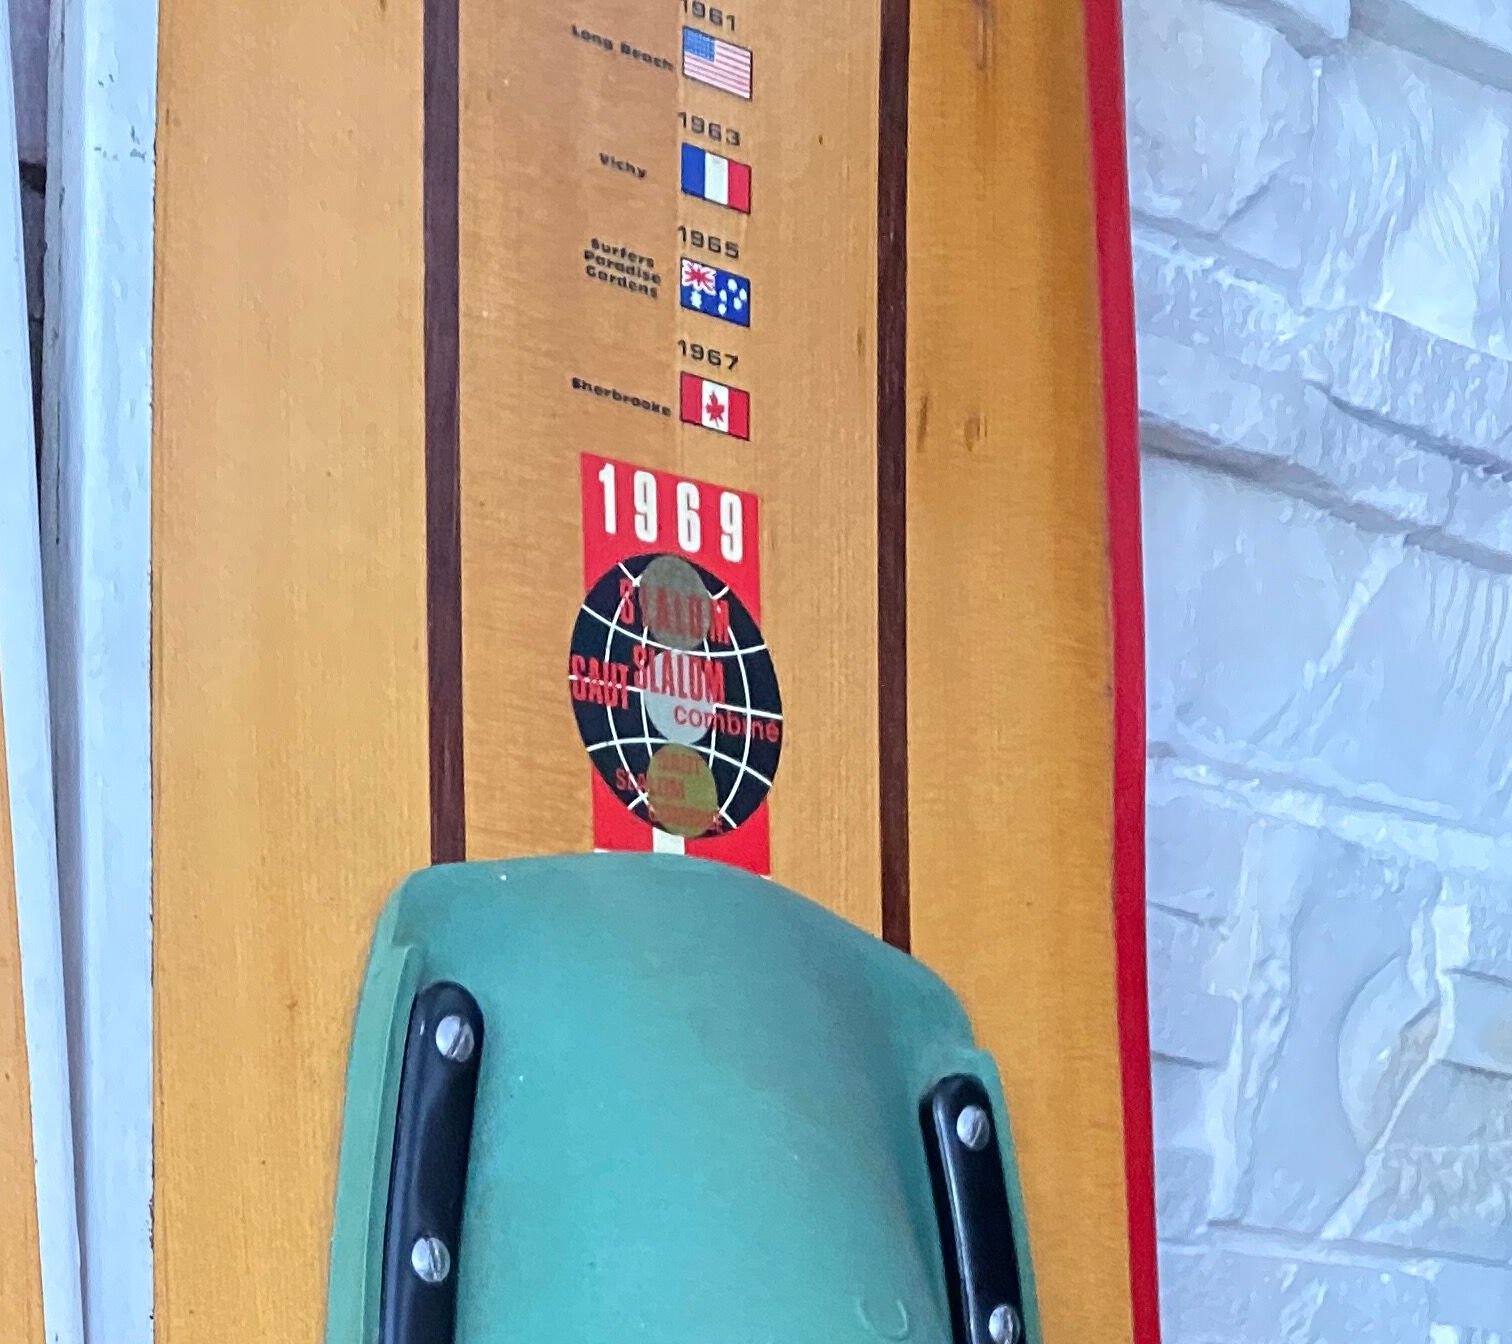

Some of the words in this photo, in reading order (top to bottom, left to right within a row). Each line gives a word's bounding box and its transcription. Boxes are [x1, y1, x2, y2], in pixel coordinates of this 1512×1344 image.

[680, 0, 736, 31] 1961
[571, 24, 614, 50] Long
[620, 42, 674, 71] Beach
[677, 111, 740, 146] 1963
[599, 152, 647, 178] Vichy
[591, 238, 655, 268] Surfers
[678, 225, 739, 259] 1965
[584, 250, 661, 284] Paradise
[585, 265, 658, 298] Gardens
[678, 339, 739, 370] 1967
[598, 463, 744, 563] 1969
[571, 654, 630, 710] SAUT
[633, 644, 726, 704] SLALOM
